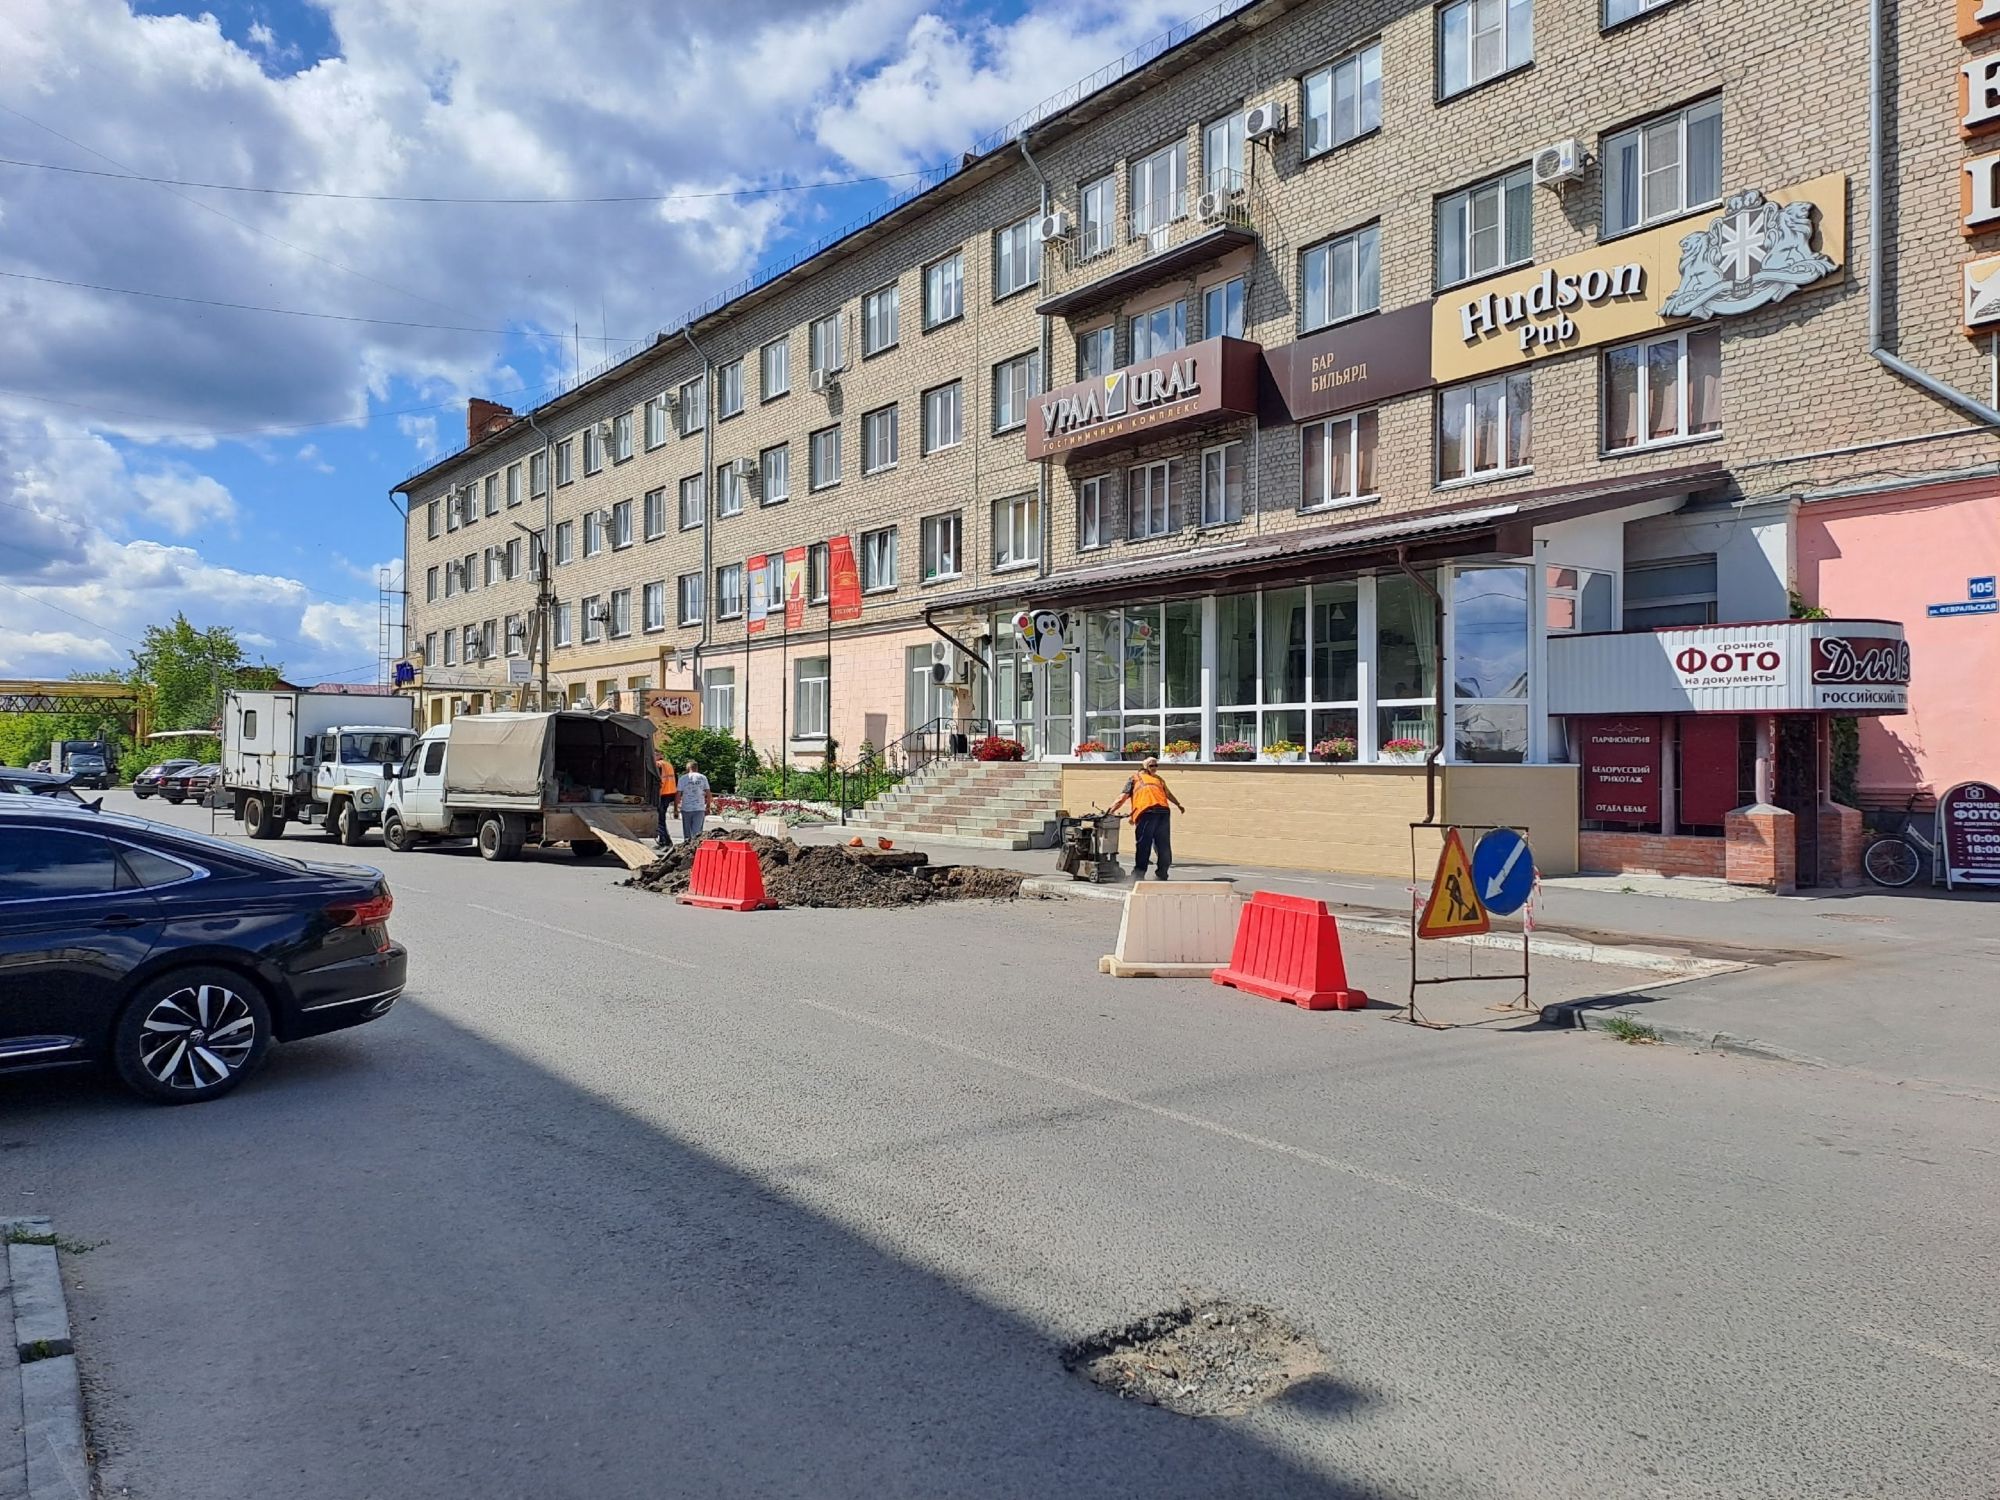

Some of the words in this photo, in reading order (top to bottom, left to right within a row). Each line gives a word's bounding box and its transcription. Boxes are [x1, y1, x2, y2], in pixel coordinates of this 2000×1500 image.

[1457, 260, 1645, 343] Hudson
[1518, 315, 1575, 351] Pub
[1312, 352, 1335, 371] БАР
[1130, 357, 1201, 406] URAL
[1311, 362, 1368, 393] БИЛЬЯРД
[1040, 388, 1102, 433] УРАЛ
[1042, 421, 1124, 453] ГОСТИНИЧНЫЙ
[1131, 401, 1199, 427] КОМПЛЕКС
[1970, 582, 1993, 594] 105
[1939, 603, 1996, 613] ФЕВРАЛЬСКАЯ
[1717, 641, 1774, 652] срочное
[1813, 636, 1897, 682] Для
[1685, 677, 1699, 685] на
[1702, 675, 1776, 686] документы
[1822, 688, 1896, 703] РОССИЙСКИЙ
[1592, 736, 1650, 744] ПАРФЮМЕРИЯ
[1592, 765, 1650, 774] БЕЛОРУССКИЙ
[1600, 775, 1643, 783] ТРИКОТАЖ
[1595, 804, 1622, 812] ОТДЕЛ
[1953, 809, 2000, 820] ФОТО
[1965, 834, 2000, 843] 10:00
